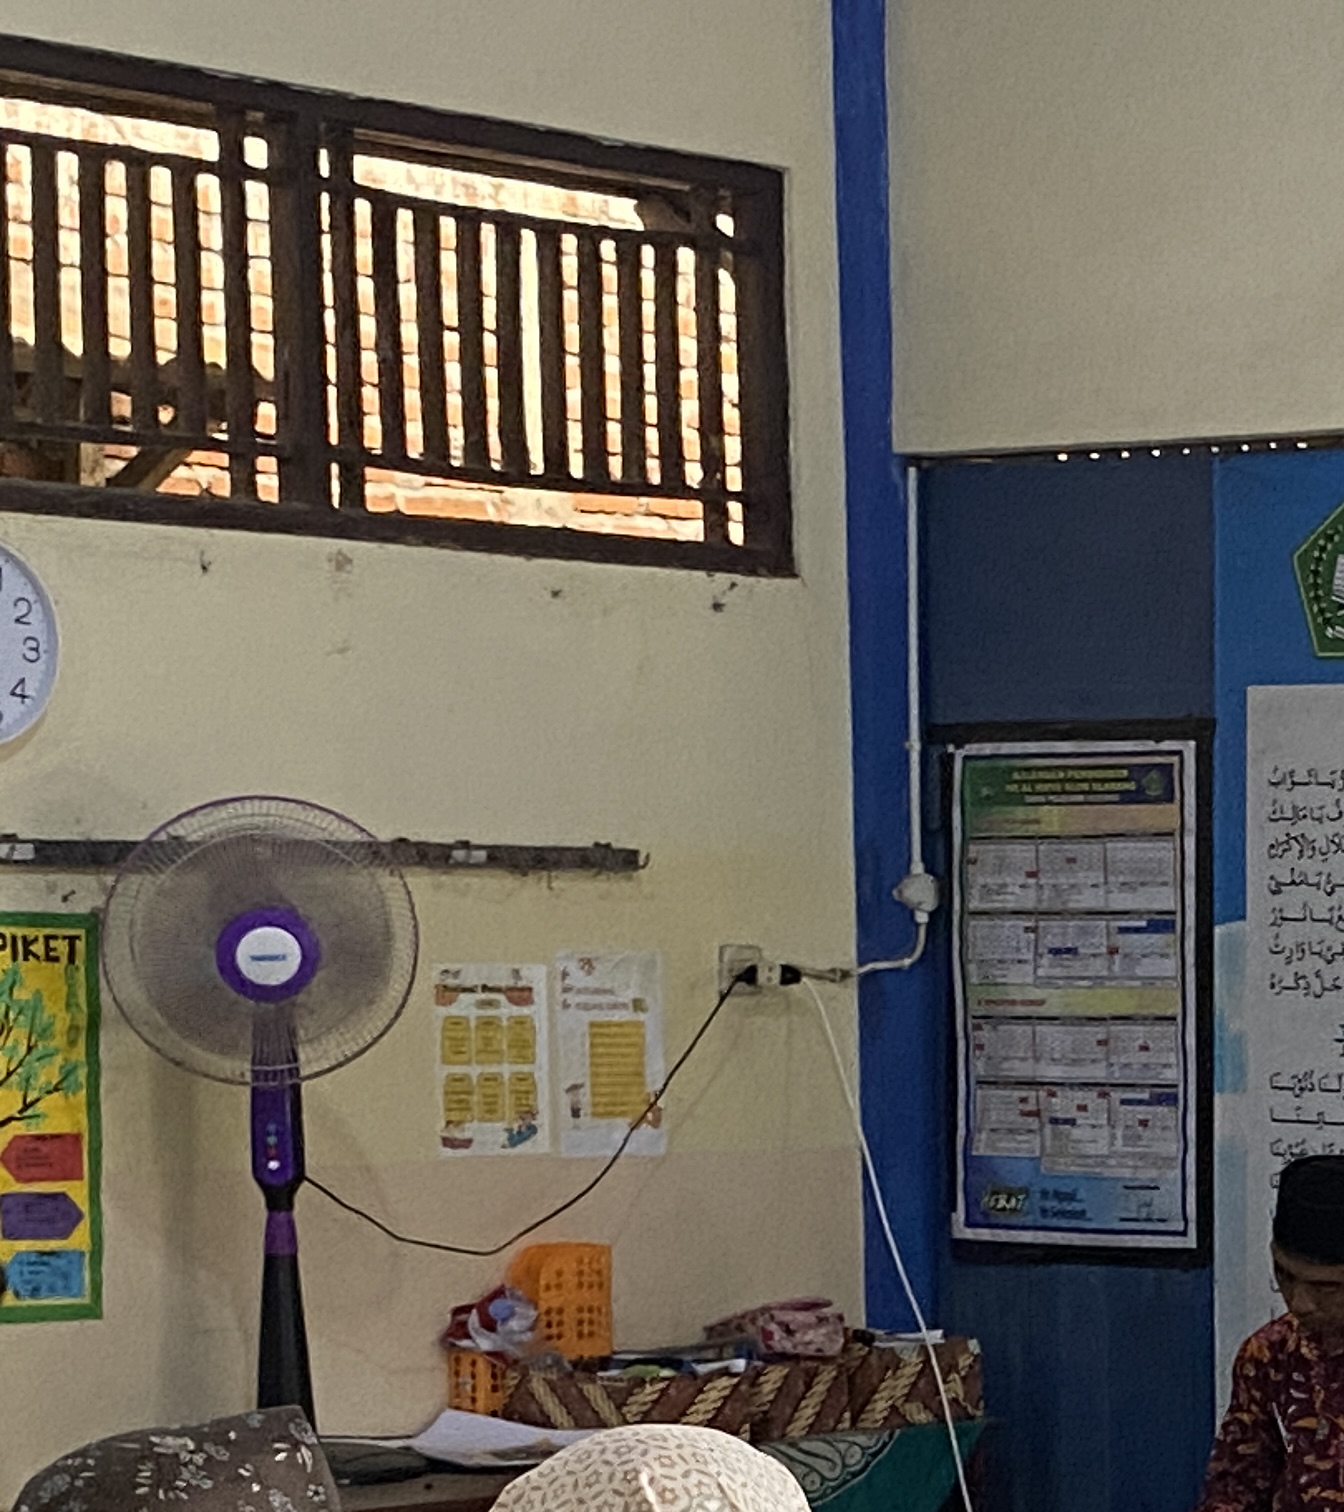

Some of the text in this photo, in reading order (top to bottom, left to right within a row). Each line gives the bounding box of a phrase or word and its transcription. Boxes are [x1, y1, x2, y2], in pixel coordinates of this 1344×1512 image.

[13, 596, 33, 625] 2
[22, 636, 41, 664] 3
[9, 677, 35, 704] 4
